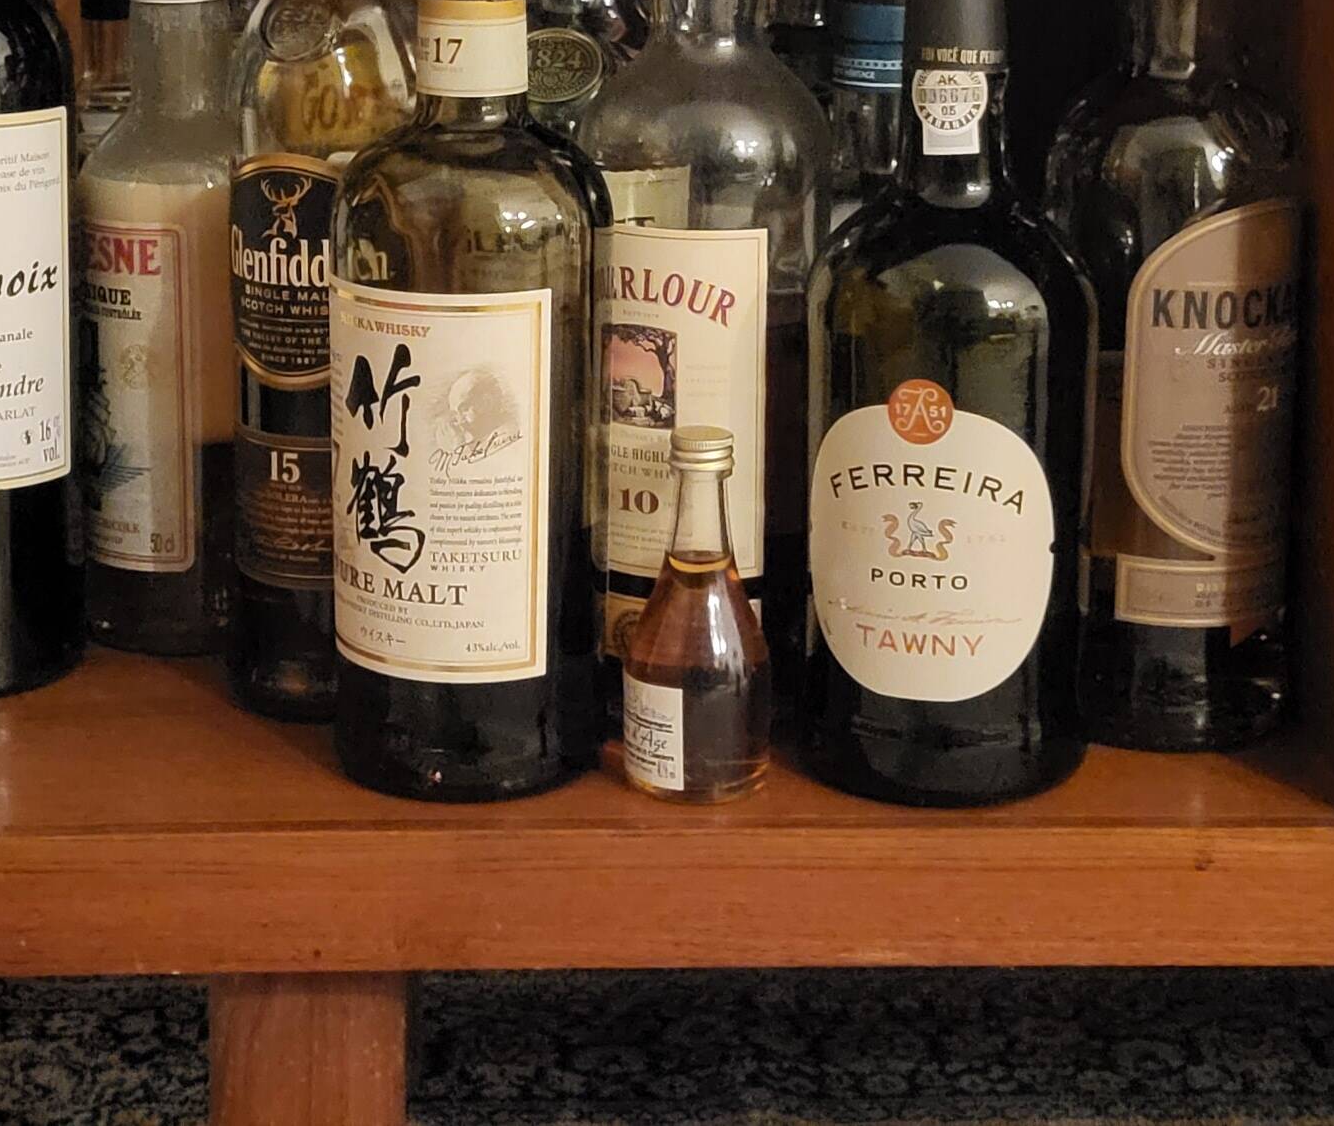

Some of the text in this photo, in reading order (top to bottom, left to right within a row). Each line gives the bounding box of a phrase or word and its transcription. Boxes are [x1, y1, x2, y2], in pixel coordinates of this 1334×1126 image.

[432, 36, 464, 65] 17
[936, 73, 958, 86] AK
[86, 232, 162, 277] ESNE
[244, 283, 330, 302] SINGLE MAL
[597, 265, 737, 329] ERLOUR
[240, 296, 330, 316] SCOTCH WHIS
[374, 320, 432, 338] WHISKY
[894, 402, 947, 418] 17 51
[38, 418, 53, 444] 16
[345, 342, 427, 575] 竹鶴
[611, 443, 670, 464] GLE HIGHL
[269, 450, 302, 484] 15
[618, 488, 661, 515] 10
[829, 463, 1027, 516] FERREIRA
[429, 549, 523, 564] TAKETSURU
[430, 565, 486, 573] WHISKY
[383, 577, 468, 606] MALT
[870, 567, 969, 591] PORTO
[855, 623, 984, 657] TAWNY
